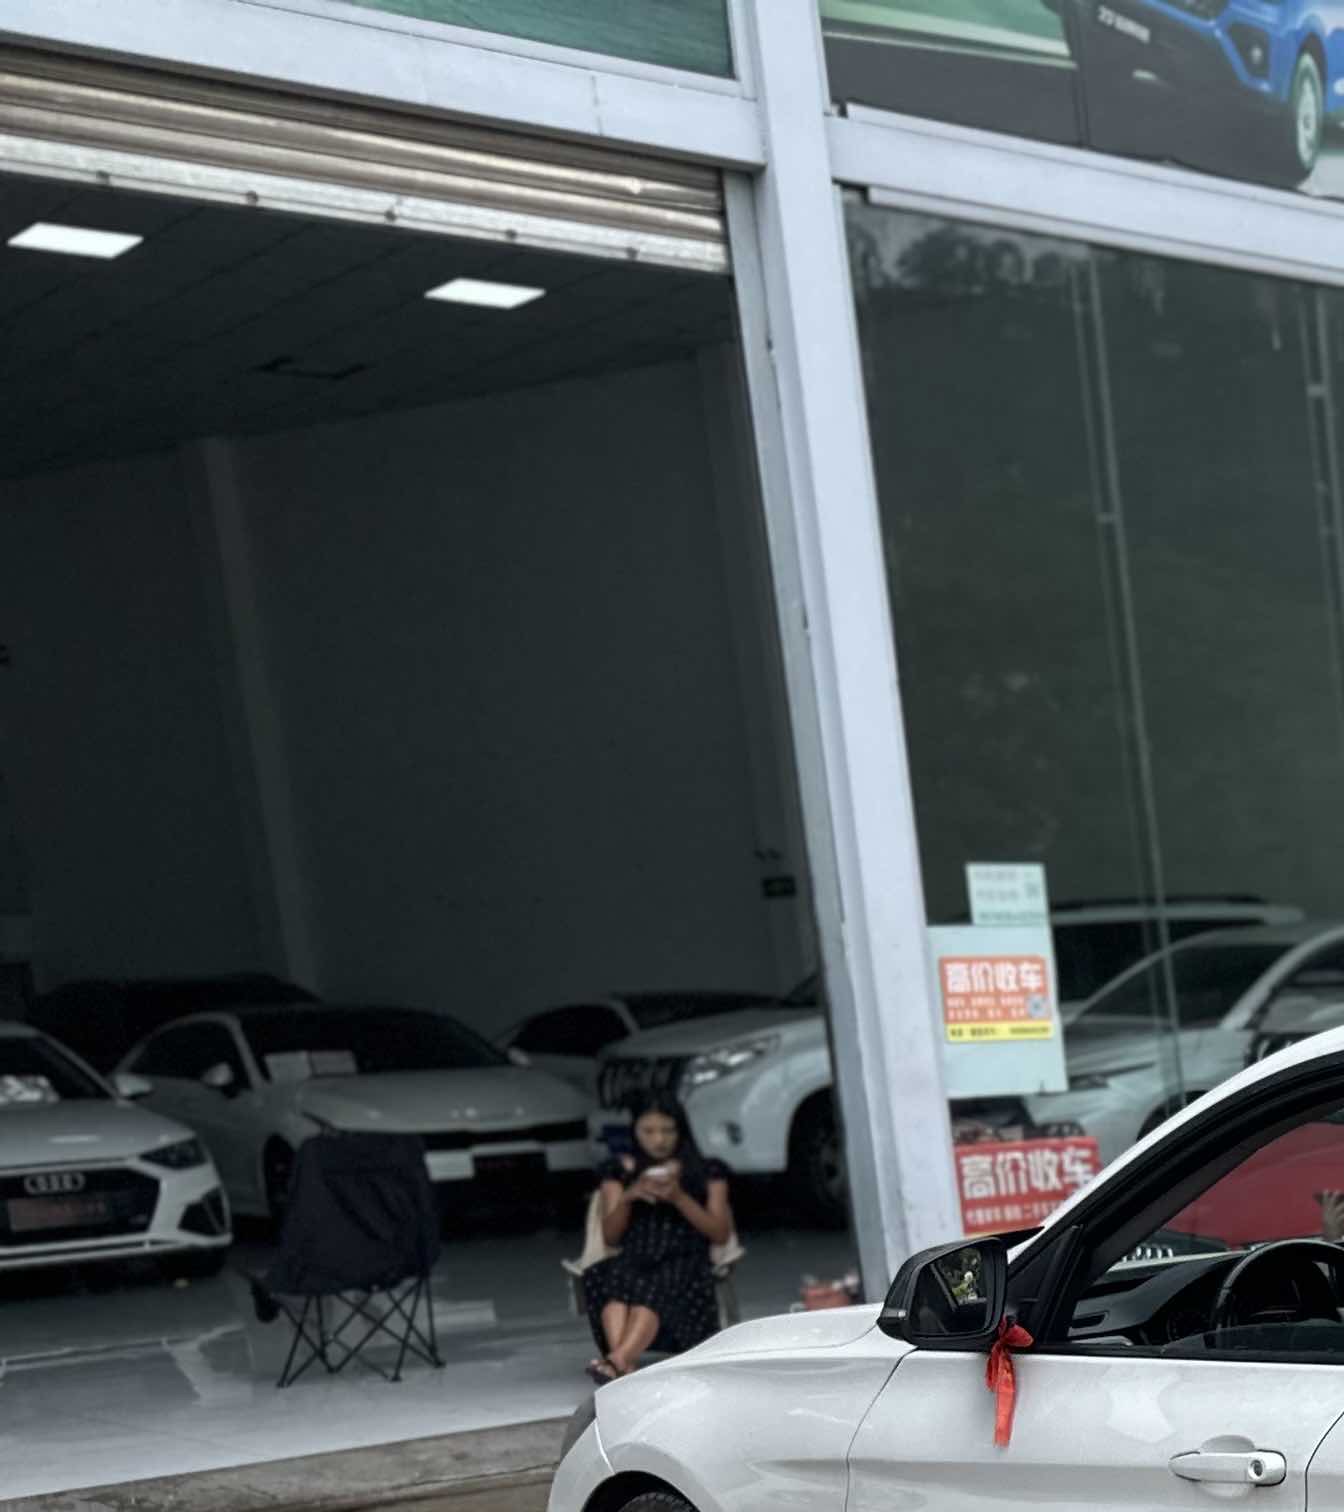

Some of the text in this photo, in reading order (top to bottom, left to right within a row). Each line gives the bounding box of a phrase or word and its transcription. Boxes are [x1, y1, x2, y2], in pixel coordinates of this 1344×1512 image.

[945, 961, 1044, 993] 高价收车
[961, 1145, 1095, 1199] 高价收车
